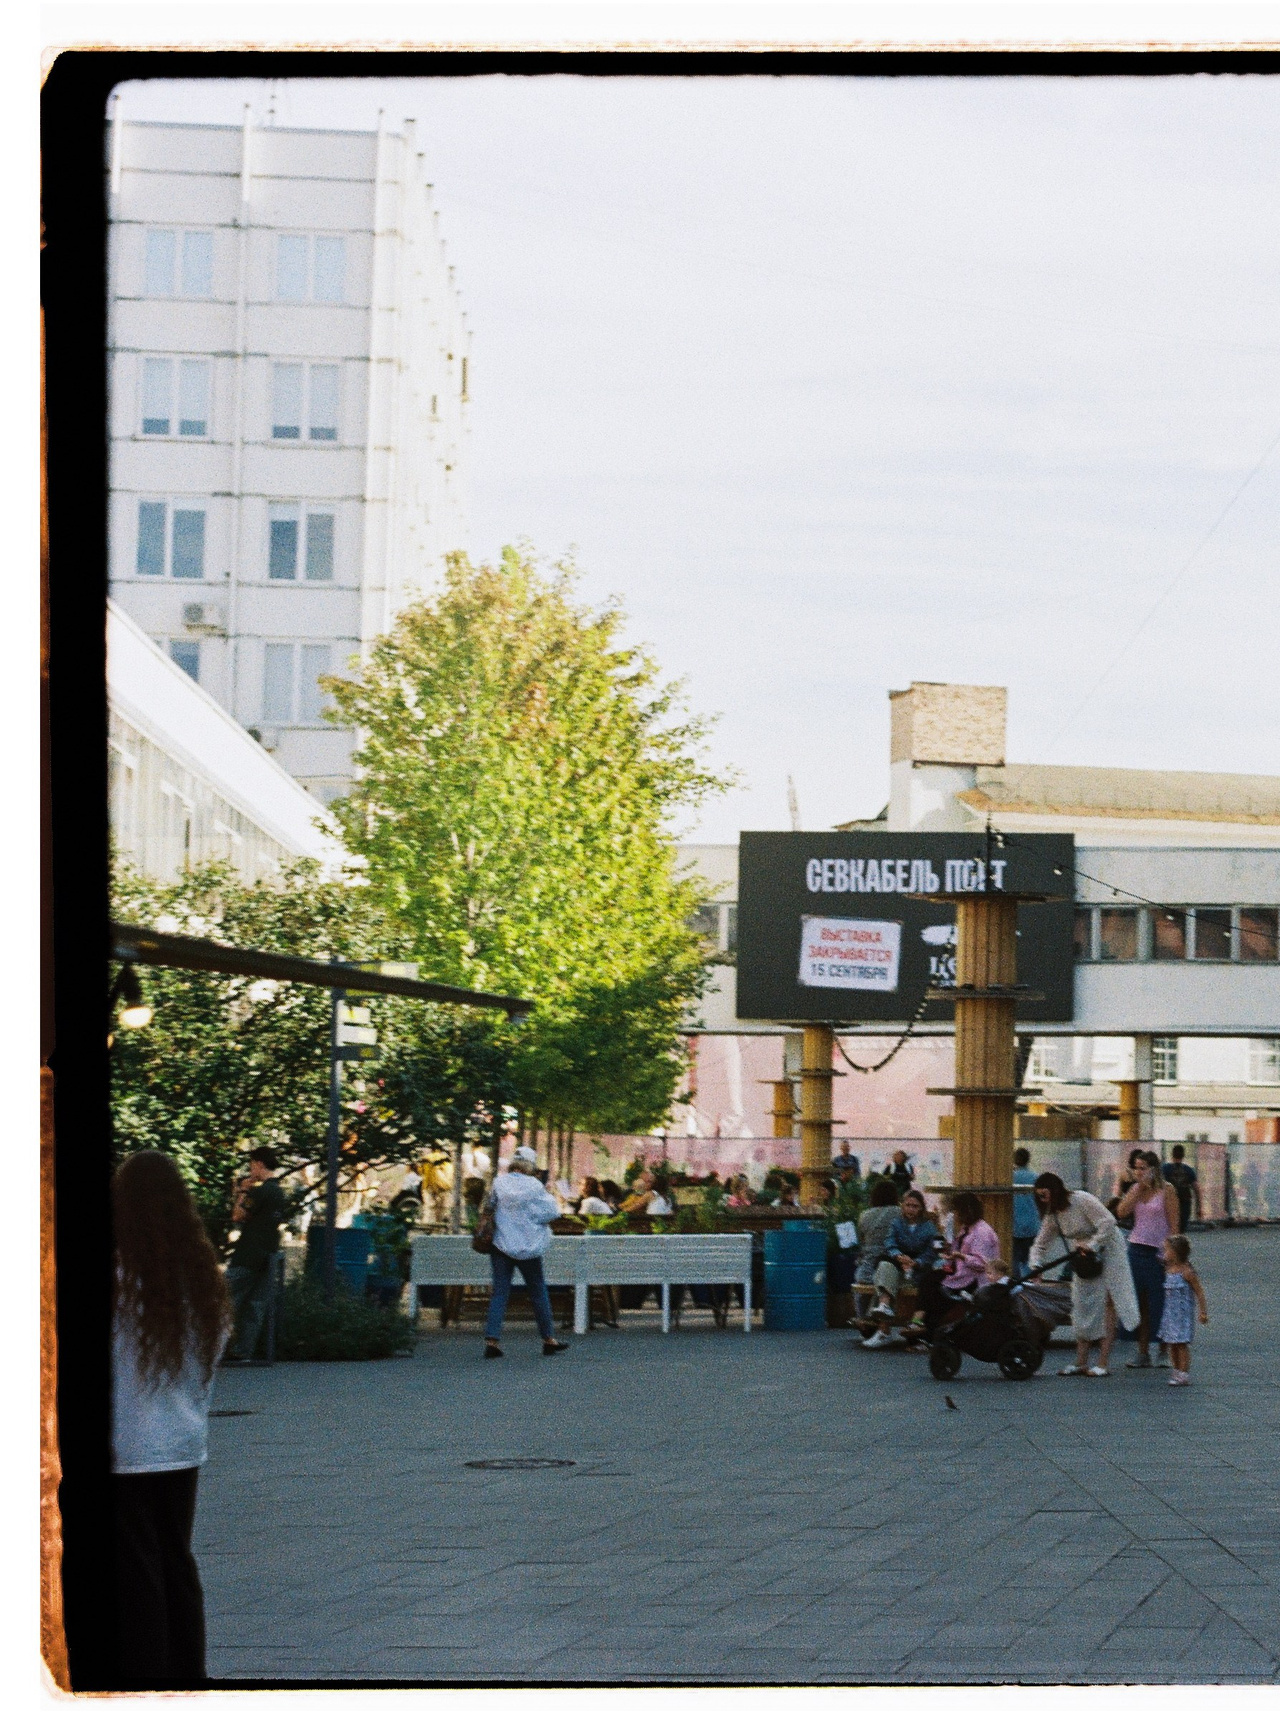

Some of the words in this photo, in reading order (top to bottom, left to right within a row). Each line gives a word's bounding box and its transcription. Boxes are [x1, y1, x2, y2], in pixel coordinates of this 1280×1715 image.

[806, 858, 941, 892] СЕВКАБЕЛЬ
[820, 927, 883, 943] ВЫСТАВКА
[808, 945, 893, 962] ЗАКРЫВАЕТСЯ
[811, 963, 825, 977] 15
[827, 964, 889, 980] СЕНТЯБРЯ
